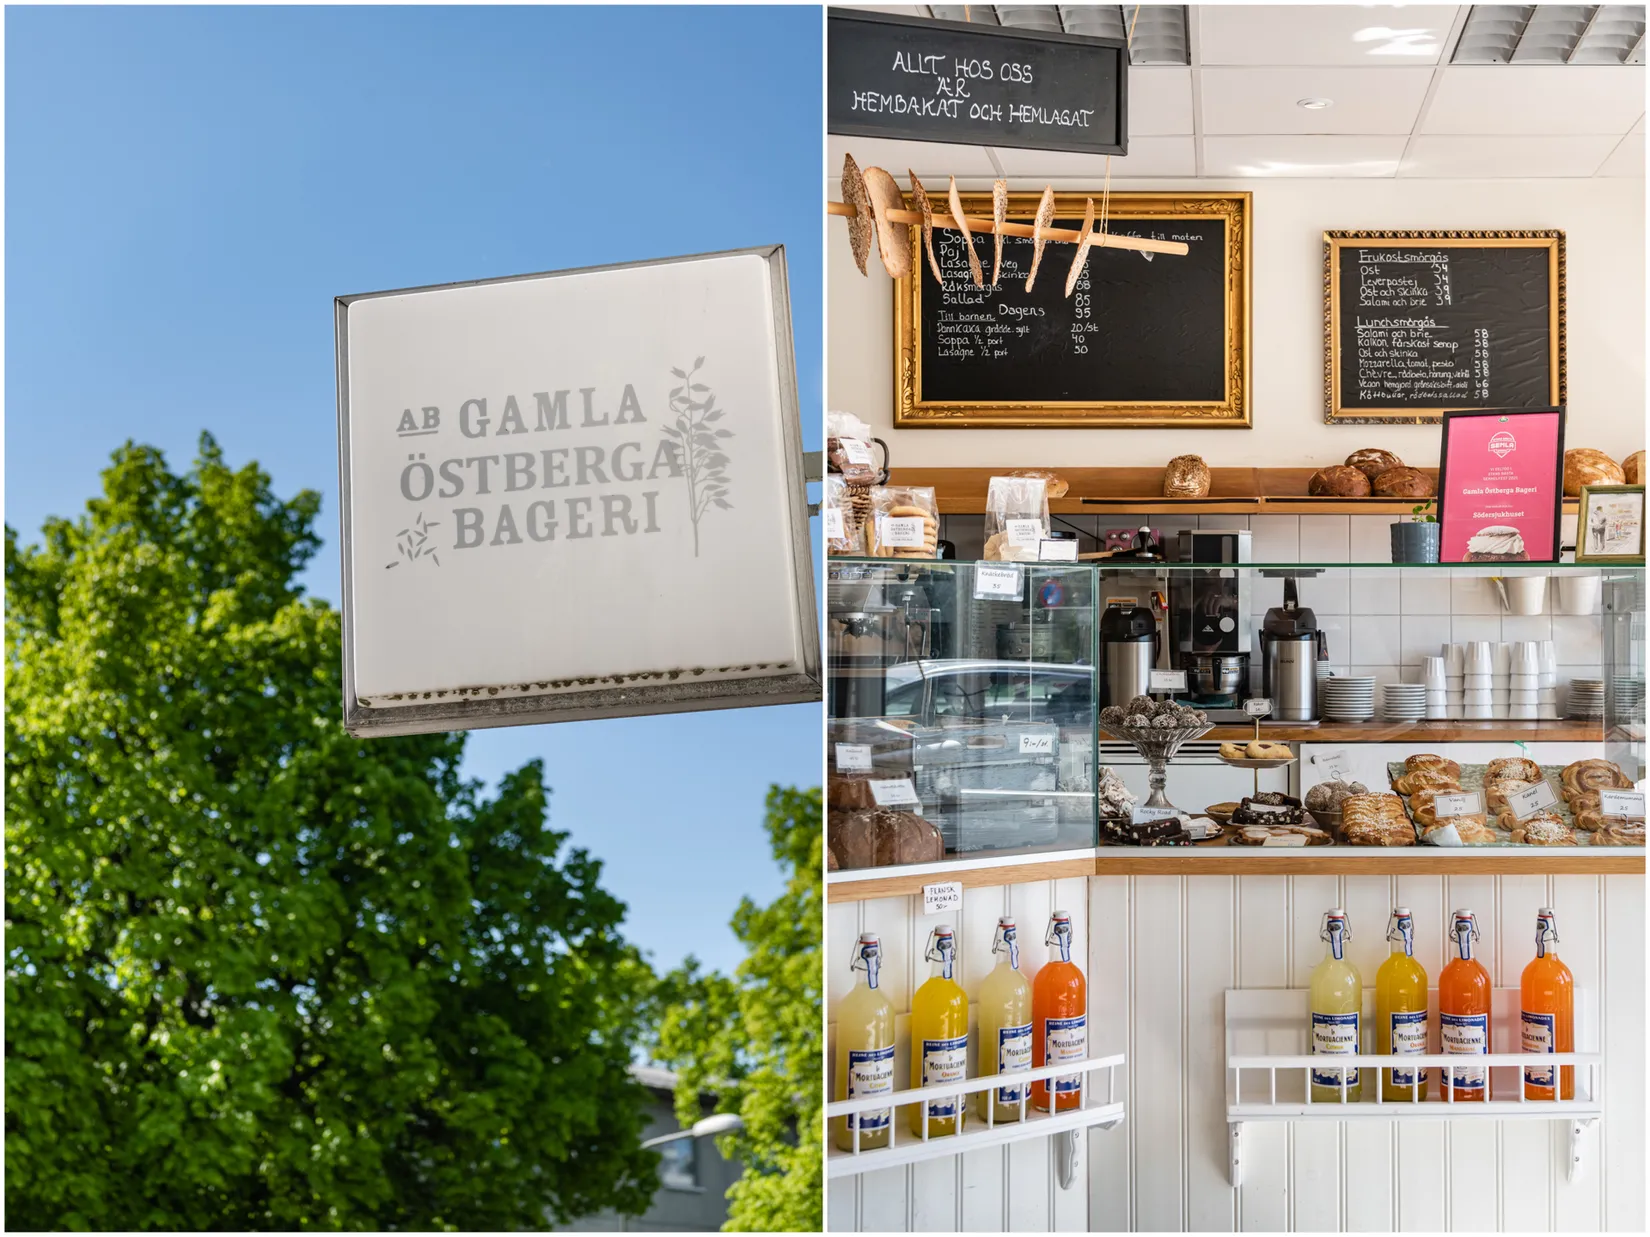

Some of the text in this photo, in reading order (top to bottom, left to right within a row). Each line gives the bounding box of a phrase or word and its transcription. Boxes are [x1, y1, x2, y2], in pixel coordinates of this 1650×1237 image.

[892, 51, 1033, 83] ALLT HOS OSS
[936, 77, 971, 98] ÄR
[851, 91, 1095, 127] HEMBAKAT OCH HEMLAGAT
[1172, 232, 1204, 241] maten
[940, 243, 959, 260] Paj
[1360, 263, 1448, 275] Ost 34
[1076, 280, 1091, 290] 88
[1361, 274, 1449, 290] Leverpastej 34
[1360, 286, 1378, 297] Ost
[1380, 286, 1395, 296] och
[1435, 285, 1450, 296] 39
[942, 292, 1091, 307] Sallad 85
[1359, 294, 1452, 306] Salami och brie 39
[937, 310, 954, 321] Till
[998, 303, 1091, 321] Dagens 95
[1015, 325, 1031, 337] sylt
[1357, 328, 1489, 339] Salami och brie 58
[937, 334, 970, 350] Soppa
[987, 336, 1003, 348] port
[1072, 333, 1085, 344] 40
[1433, 340, 1459, 353] senap
[1474, 339, 1489, 349] 58
[938, 346, 975, 361] Lasagne
[994, 347, 1008, 360] port
[1374, 349, 1388, 358] och
[1474, 349, 1489, 358] 58
[1474, 360, 1489, 369] 58
[1474, 368, 1489, 377] 58
[1474, 389, 1489, 399] 58
[396, 384, 647, 438] AB GAMLA
[400, 439, 685, 502] ÖSTBERGA
[1463, 486, 1538, 495] Gamla Östberga Bageri
[452, 491, 661, 549] BAGERI
[1472, 511, 1525, 519] Södersjukhuset
[1522, 788, 1538, 800] Kanel
[1530, 801, 1539, 809] 25
[930, 886, 955, 895] FRANSK
[926, 894, 959, 904] LEMONAD
[1315, 1032, 1353, 1043] MORTUACIENNE
[1444, 1034, 1482, 1045] MORTUACIENNE
